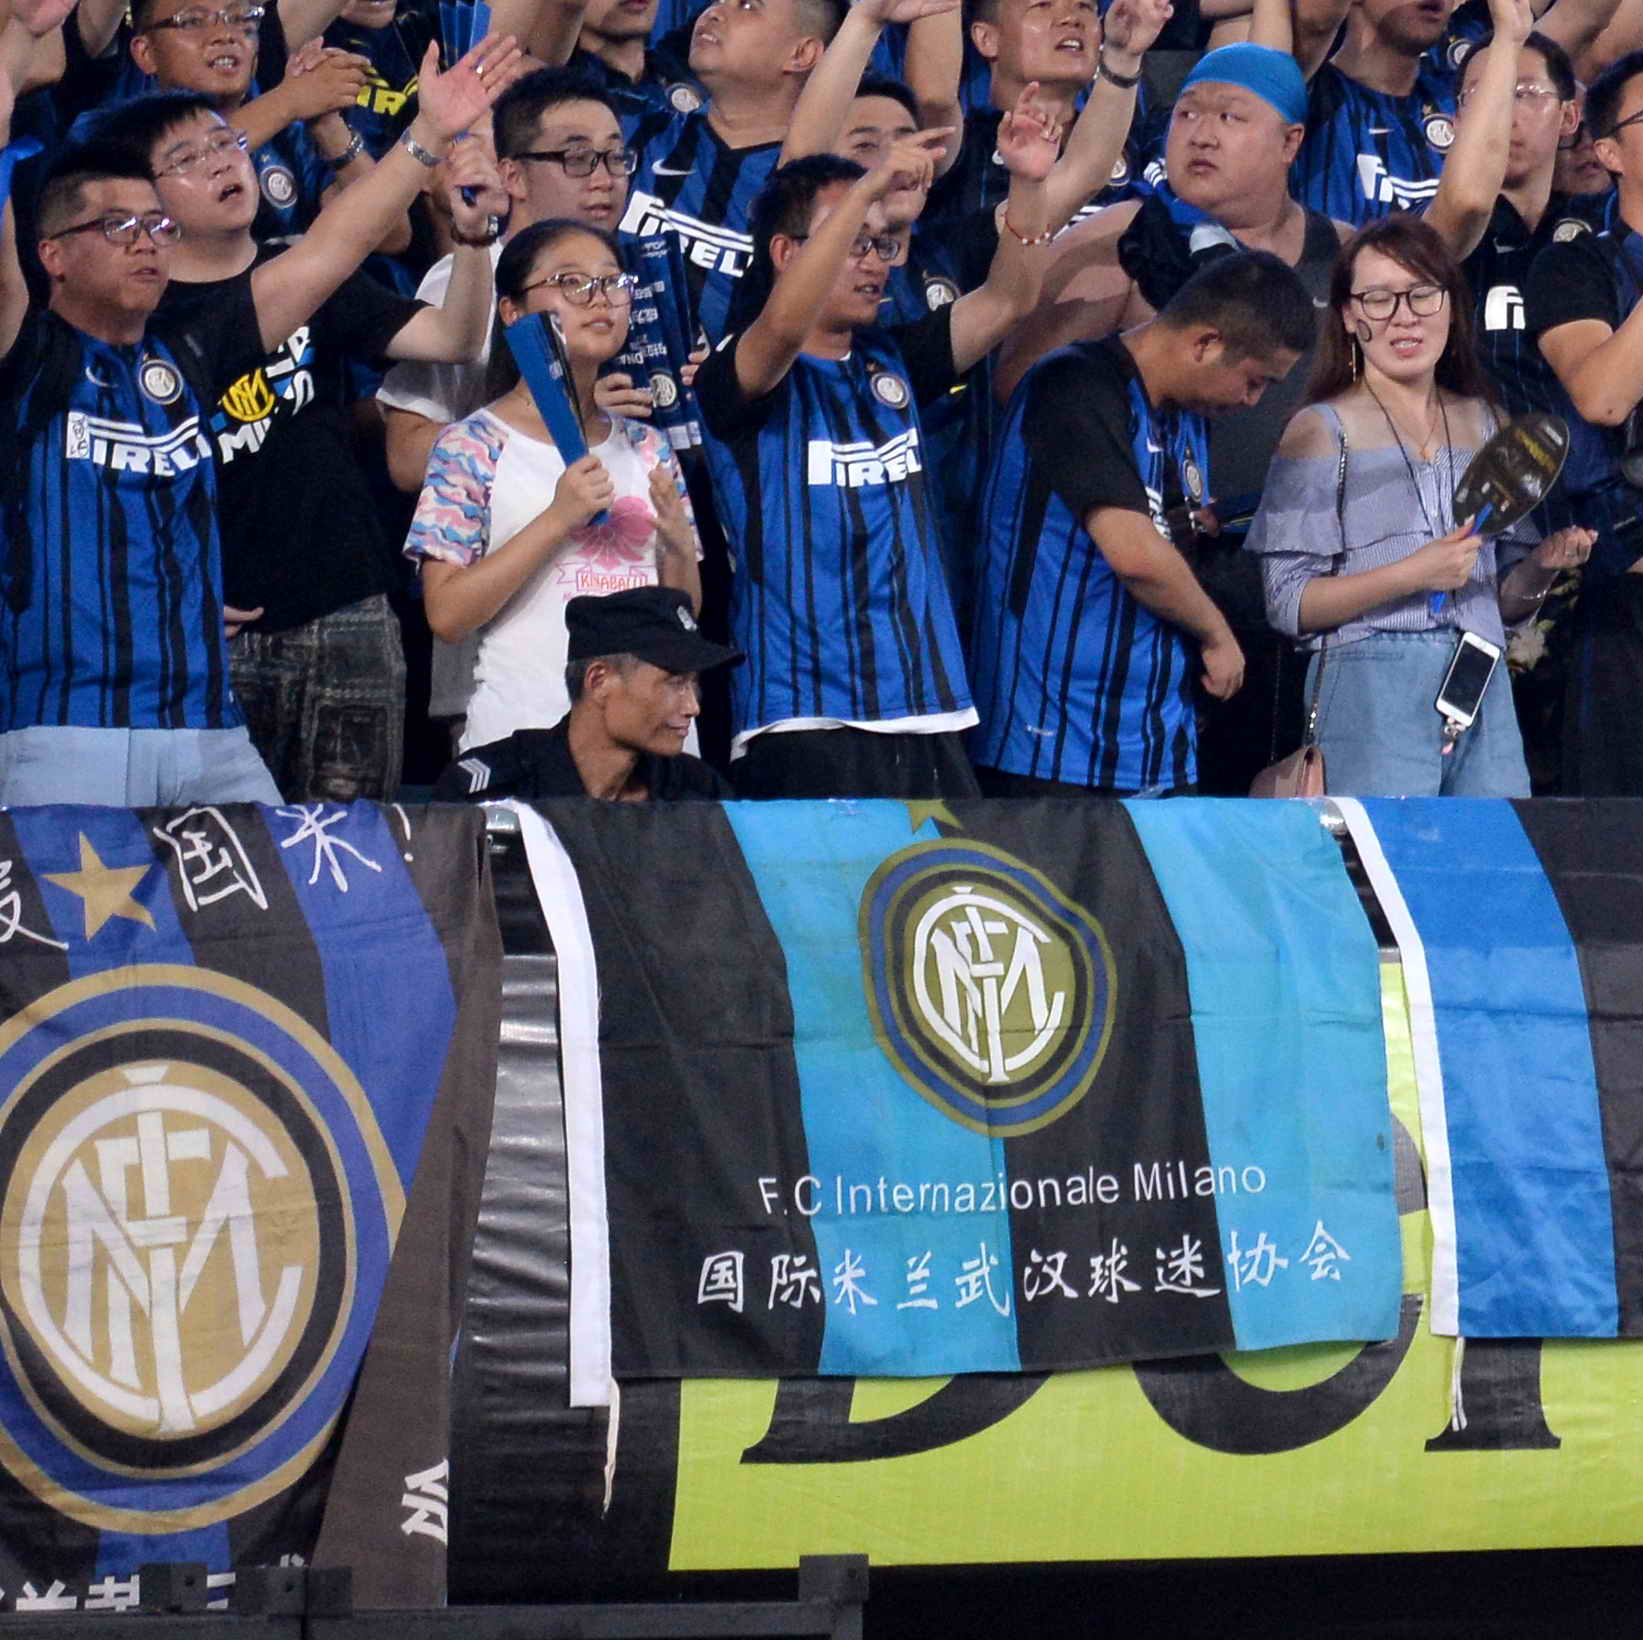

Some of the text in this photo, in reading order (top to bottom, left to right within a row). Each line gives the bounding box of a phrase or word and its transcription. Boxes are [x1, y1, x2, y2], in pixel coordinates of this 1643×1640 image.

[835, 1165, 1121, 1216] Internazionale
[1134, 1160, 1267, 1203] Milano
[695, 1218, 1353, 1318] 国际米兰武汉球迷协会
